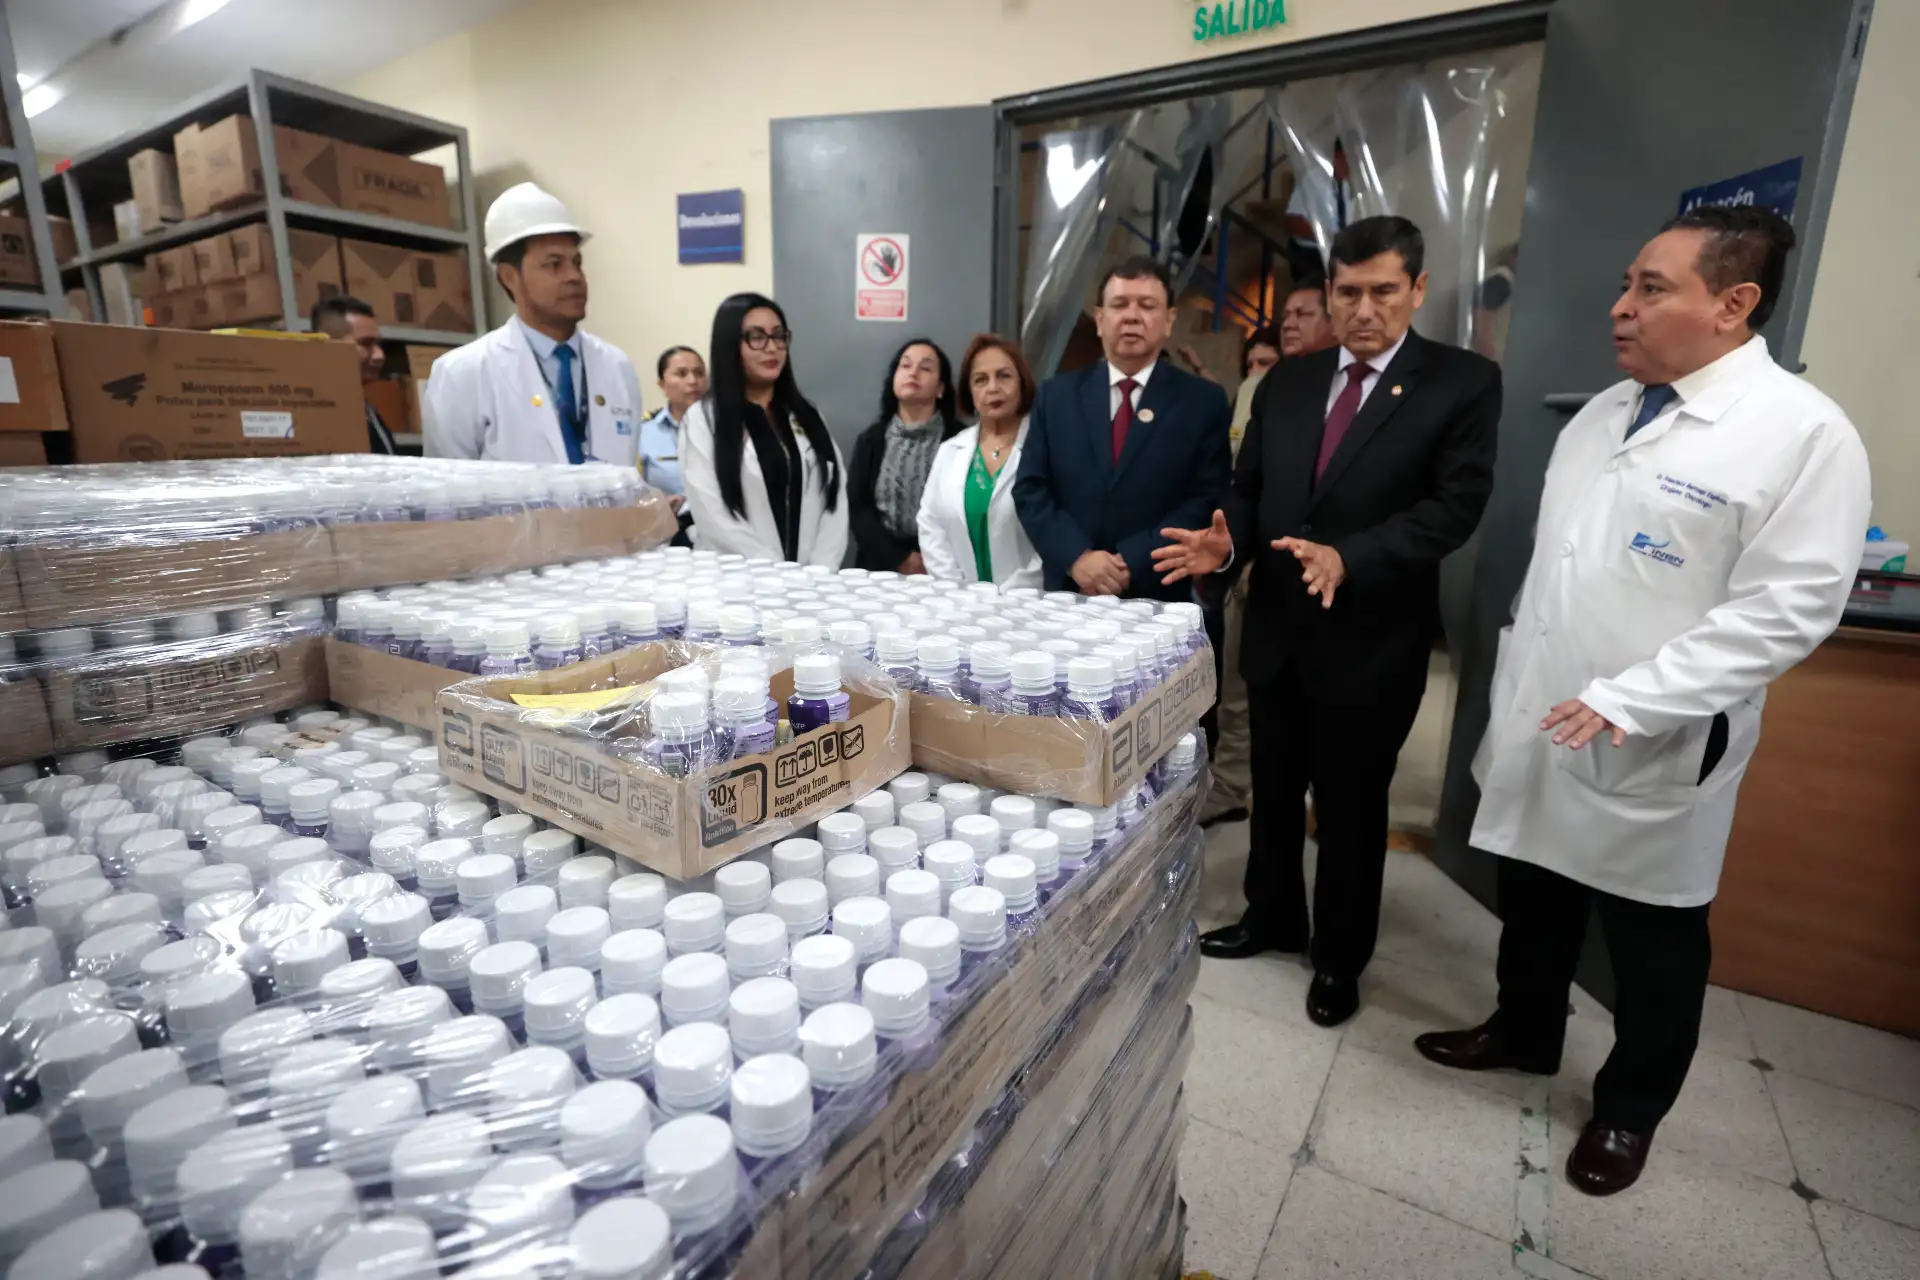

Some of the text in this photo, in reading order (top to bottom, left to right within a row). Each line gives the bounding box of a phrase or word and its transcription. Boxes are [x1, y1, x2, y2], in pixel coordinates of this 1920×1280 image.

[1194, 0, 1285, 41] SALIDA
[532, 777, 548, 794] keep
[567, 790, 583, 808] from
[774, 790, 795, 808] keep
[811, 773, 829, 790] from
[803, 779, 852, 807] temperatures
